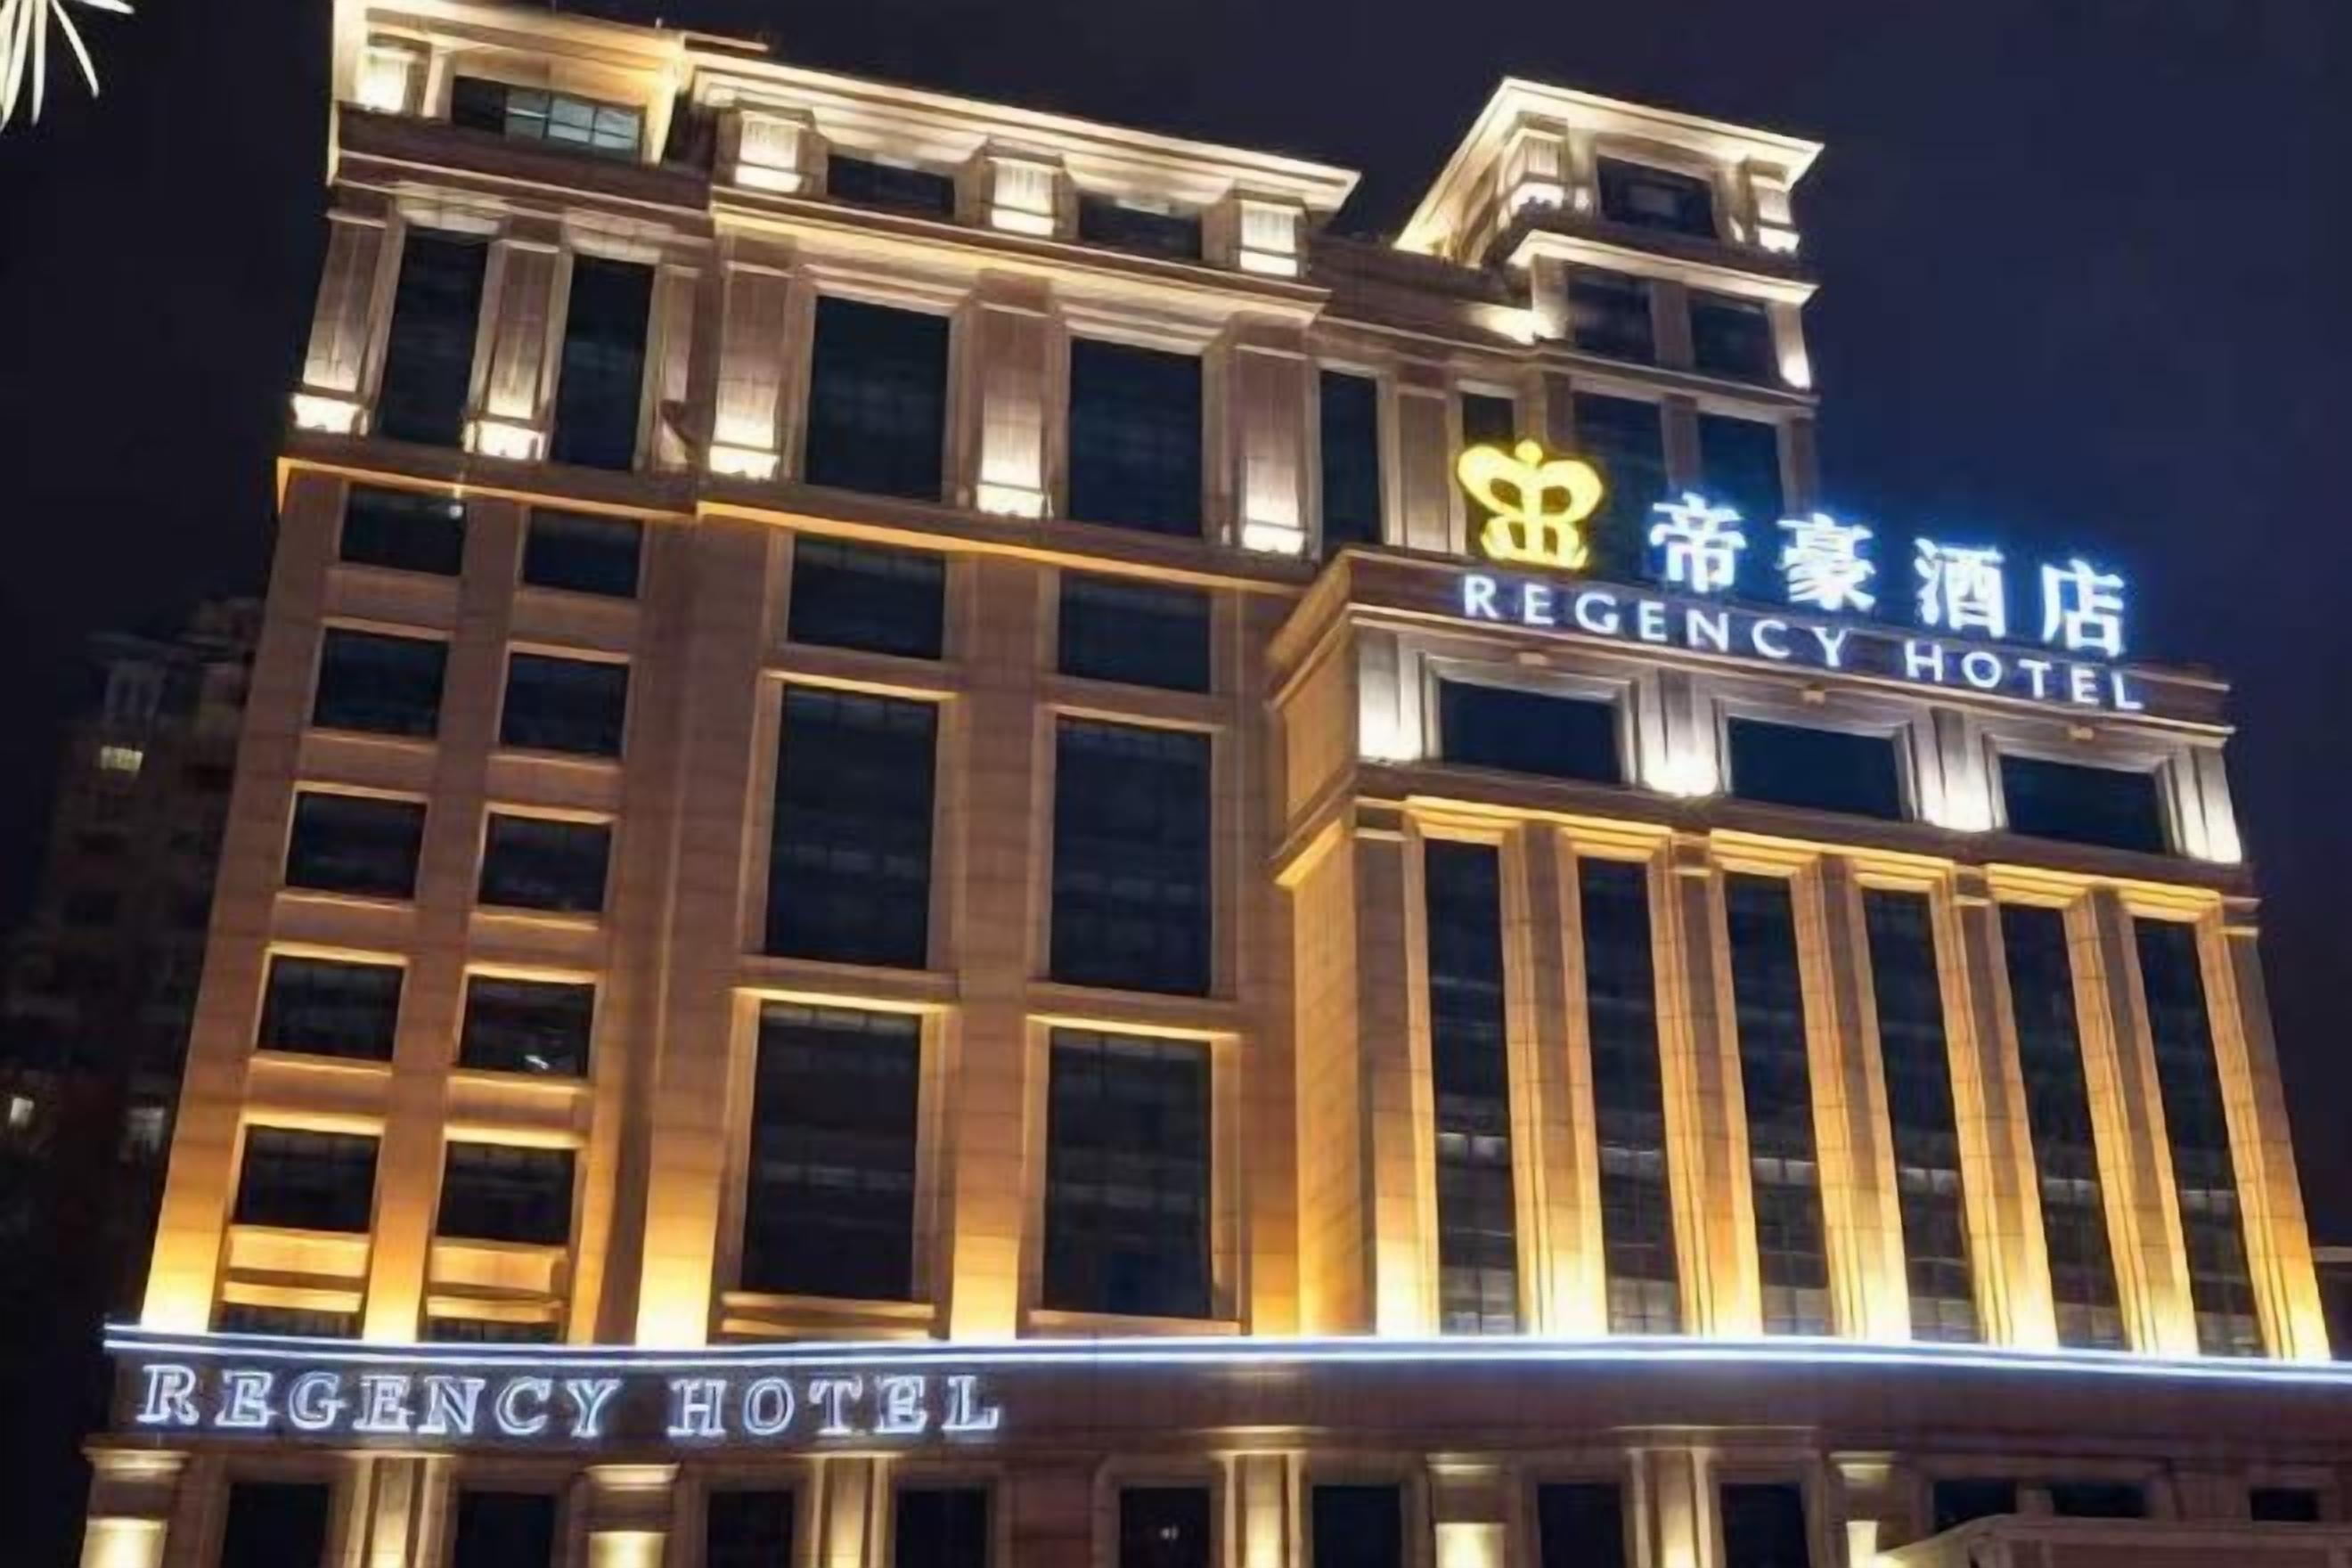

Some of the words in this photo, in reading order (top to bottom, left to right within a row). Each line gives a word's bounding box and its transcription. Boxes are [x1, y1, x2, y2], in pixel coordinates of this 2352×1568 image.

[1650, 492, 2126, 657] 帝豪酒店
[1463, 575, 1853, 667] REGENCY
[1905, 640, 2144, 709] HOTEL
[137, 1364, 623, 1437] REGENCY
[667, 1375, 999, 1437] HOTEL
